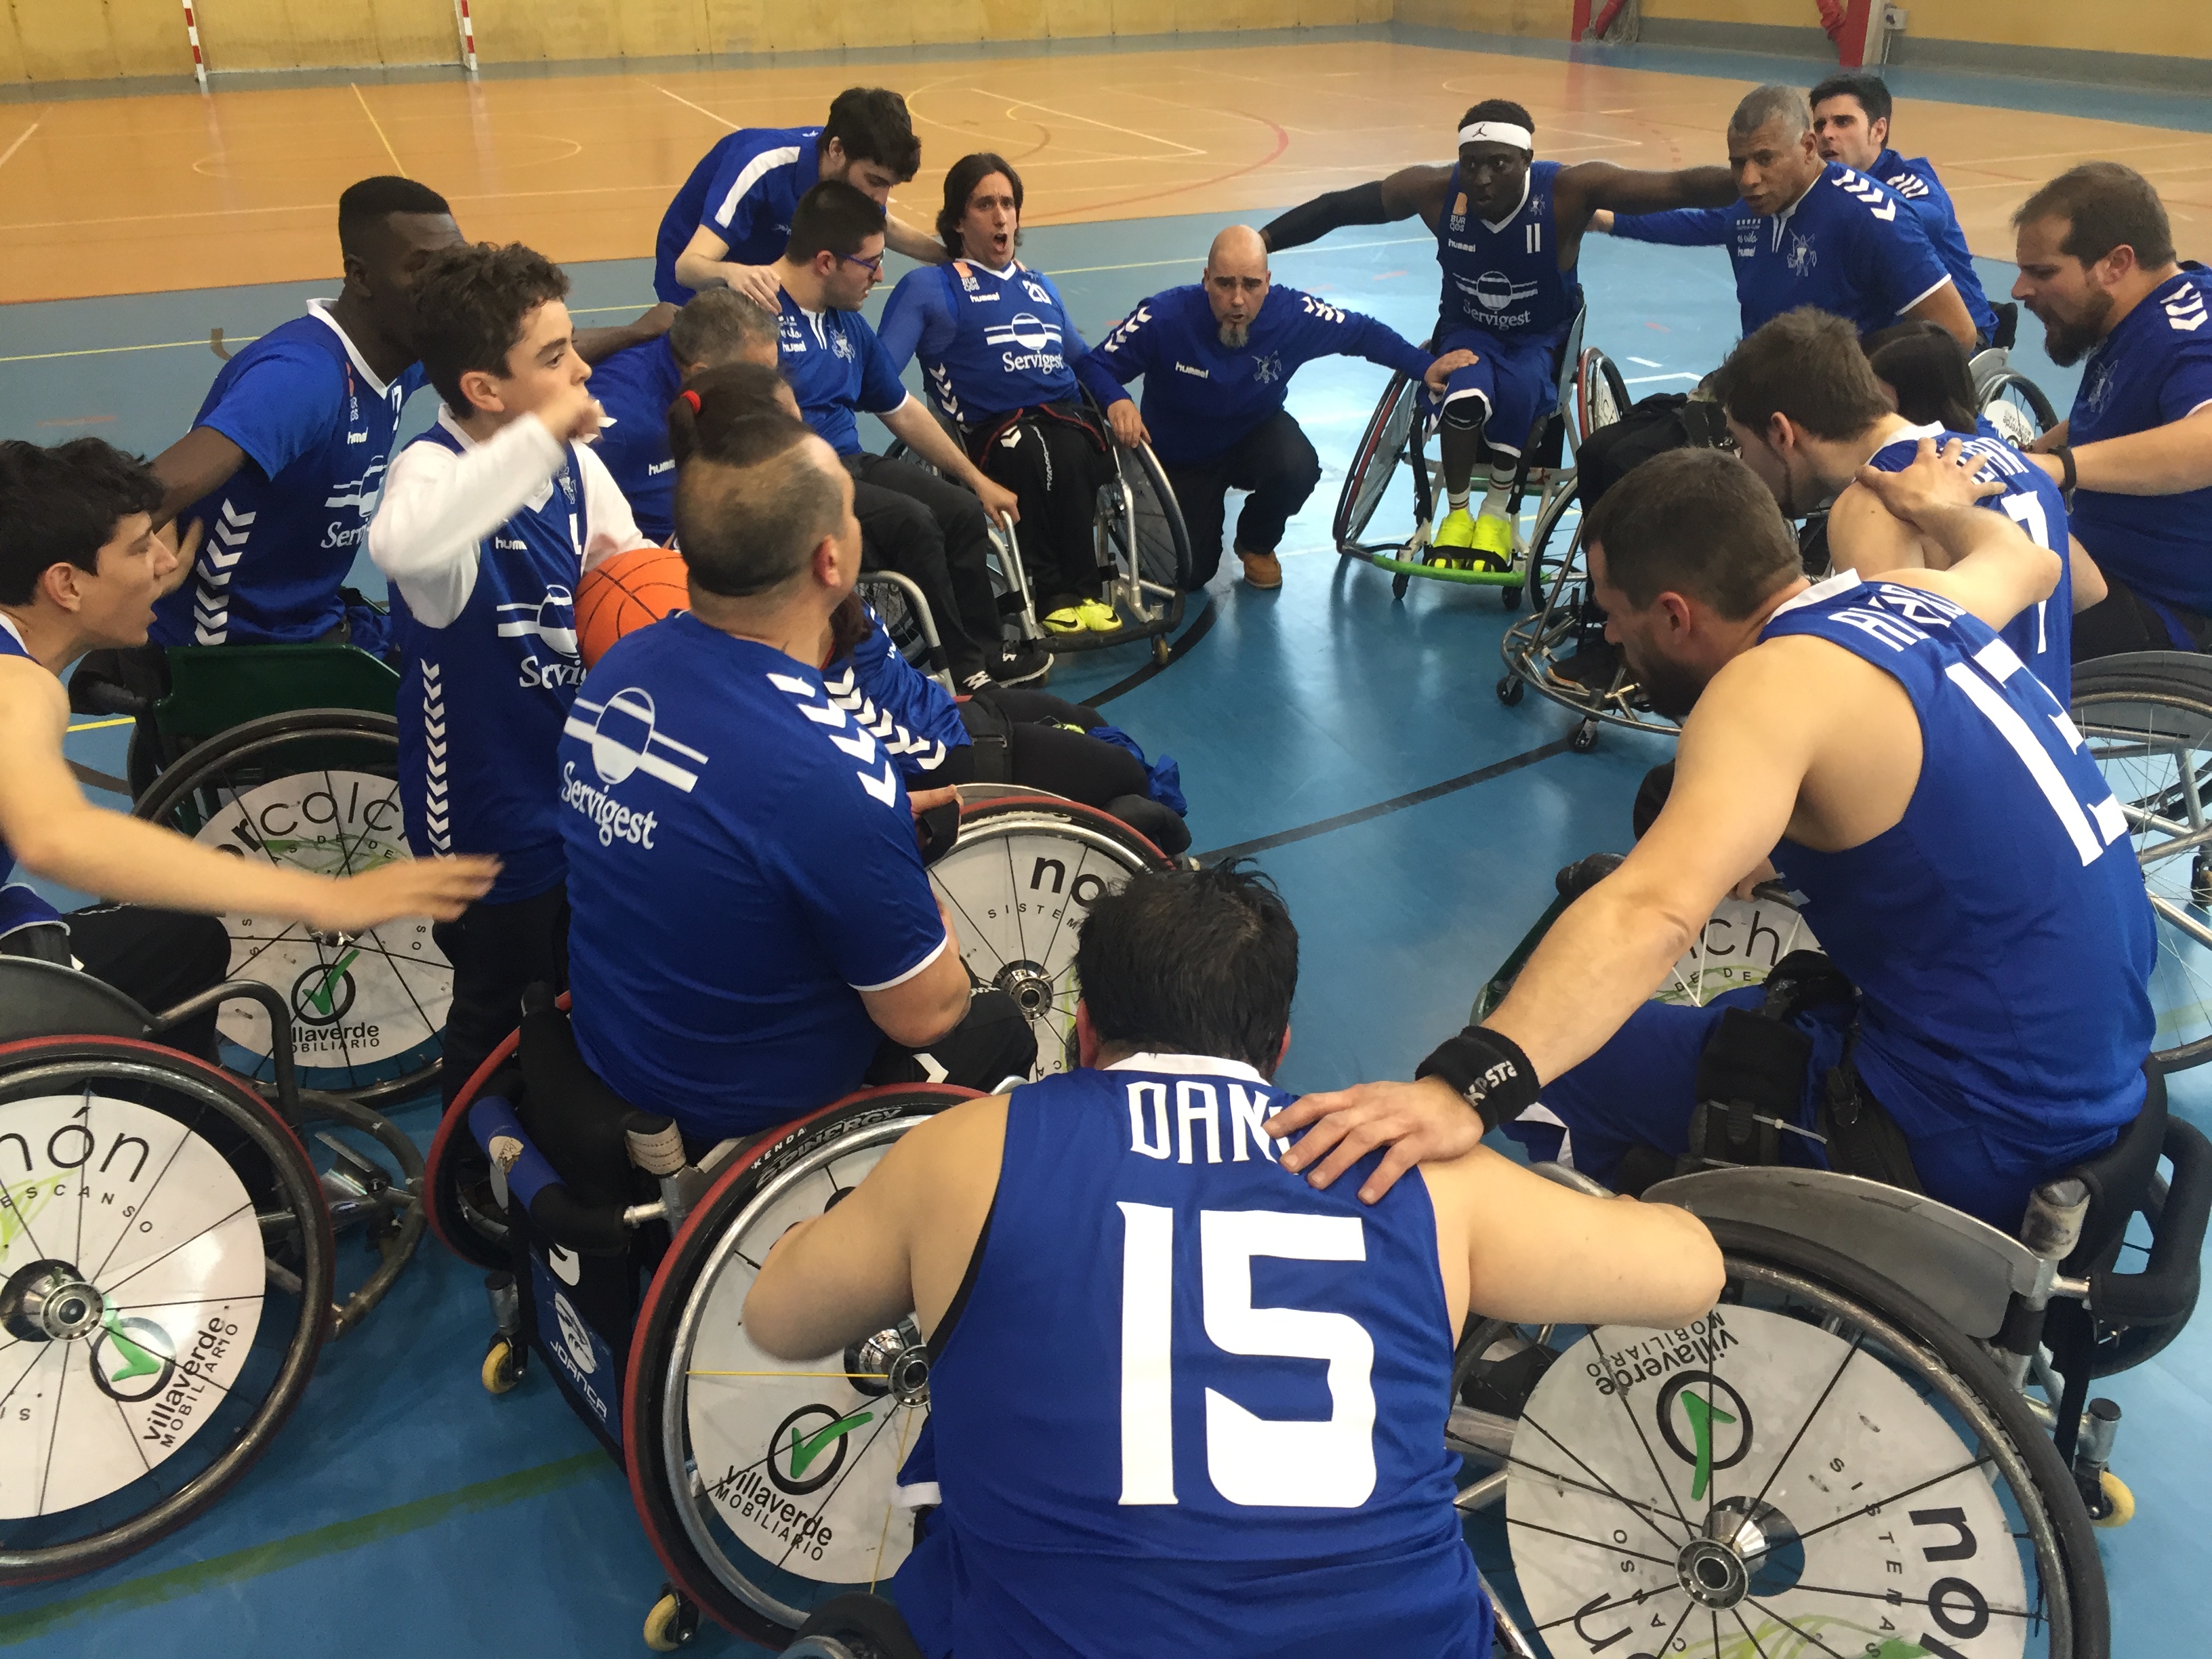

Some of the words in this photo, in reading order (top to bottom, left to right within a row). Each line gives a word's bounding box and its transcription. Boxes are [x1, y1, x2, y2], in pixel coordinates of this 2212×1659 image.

[1525, 223, 1541, 253] 11
[1022, 280, 1052, 305] 20
[1463, 298, 1531, 331] Servigest
[1002, 350, 1064, 375] Servigest
[1175, 361, 1209, 379] hummel
[561, 760, 658, 850] Servigest
[752, 1127, 806, 1170] KENDA
[143, 1317, 224, 1440] villaverde
[1116, 1202, 1377, 1509] 15
[160, 1324, 239, 1448] MOBILIARIO
[715, 1484, 823, 1561] MOBILIARIO
[720, 1465, 833, 1546] villaverde
